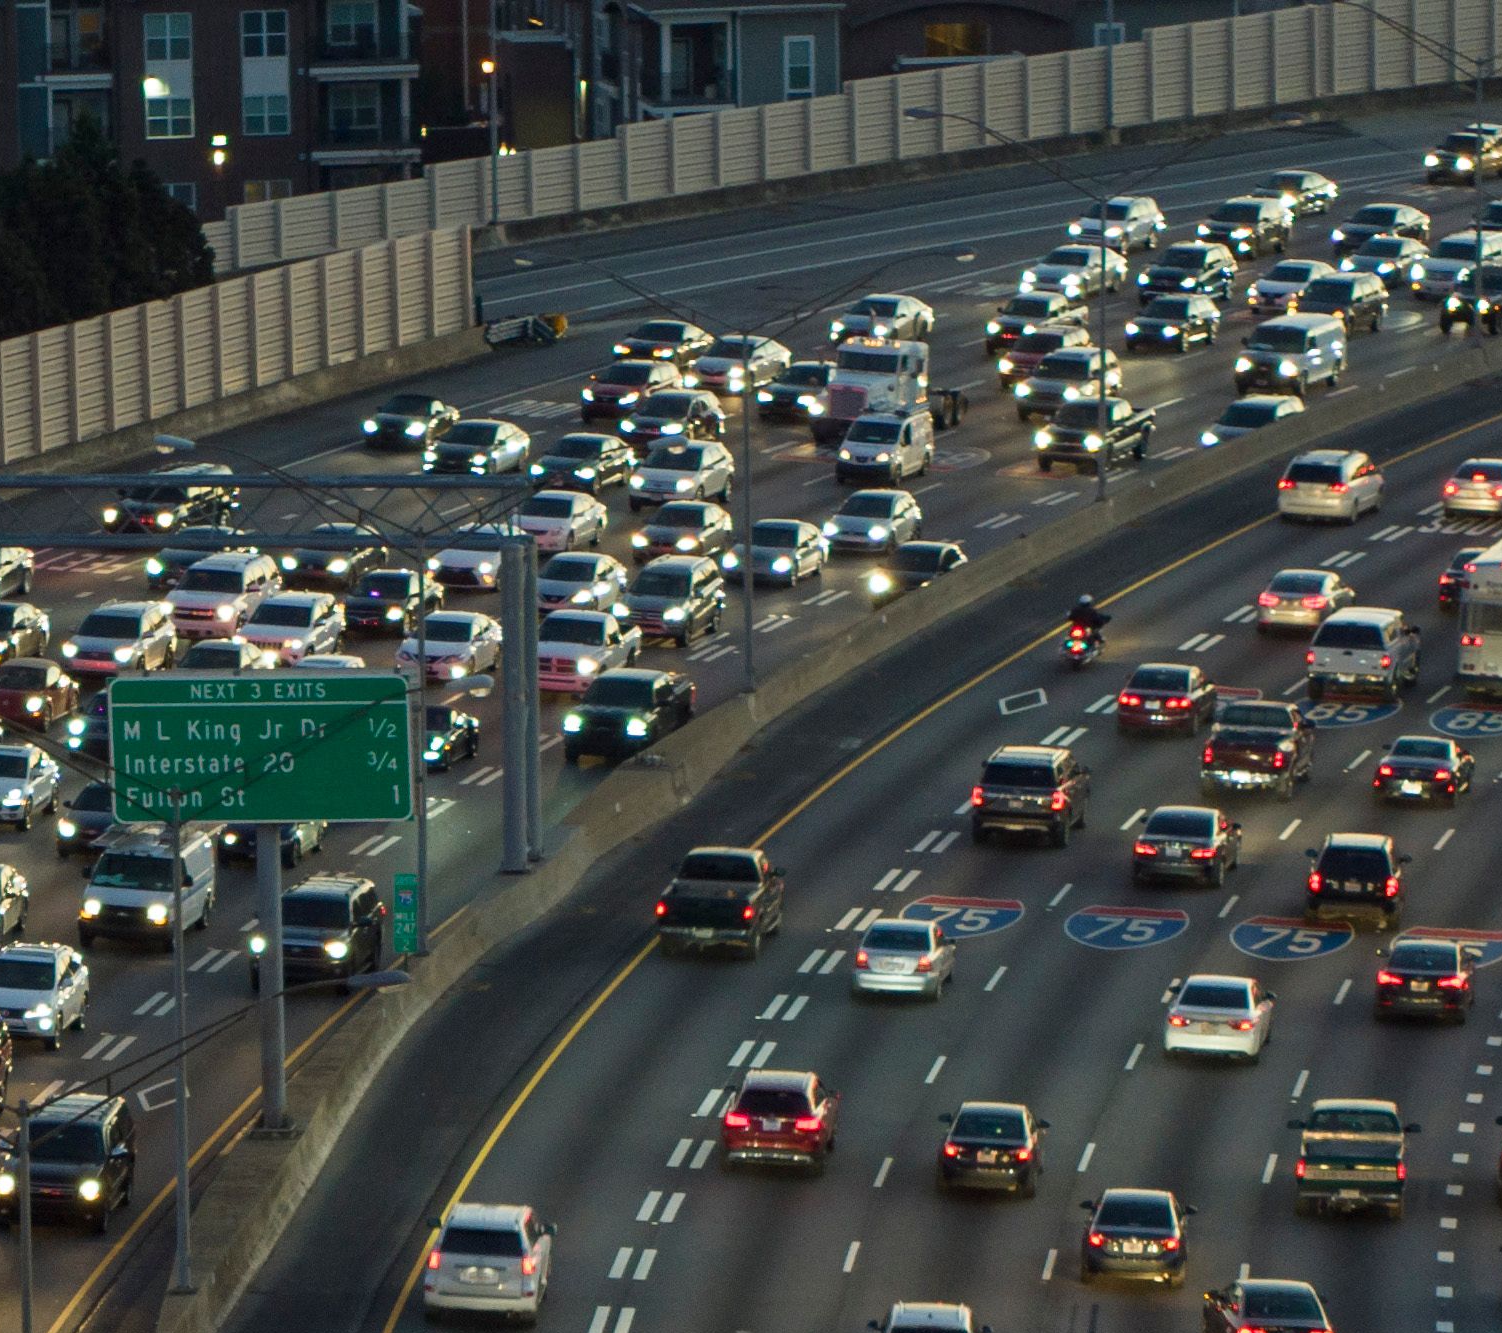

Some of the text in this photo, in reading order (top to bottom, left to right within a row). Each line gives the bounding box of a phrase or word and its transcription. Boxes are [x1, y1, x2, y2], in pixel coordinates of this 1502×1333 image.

[189, 682, 327, 699] NEXT 3 EXITS
[1305, 703, 1381, 722] 85
[123, 717, 397, 746] M L King Jr Dr 1/2
[124, 750, 398, 774] Interstate 20 3/4
[220, 786, 245, 807] St
[392, 784, 400, 805] 1
[931, 906, 998, 932] 75
[1083, 917, 1163, 942] 75
[1249, 927, 1328, 953] 75
